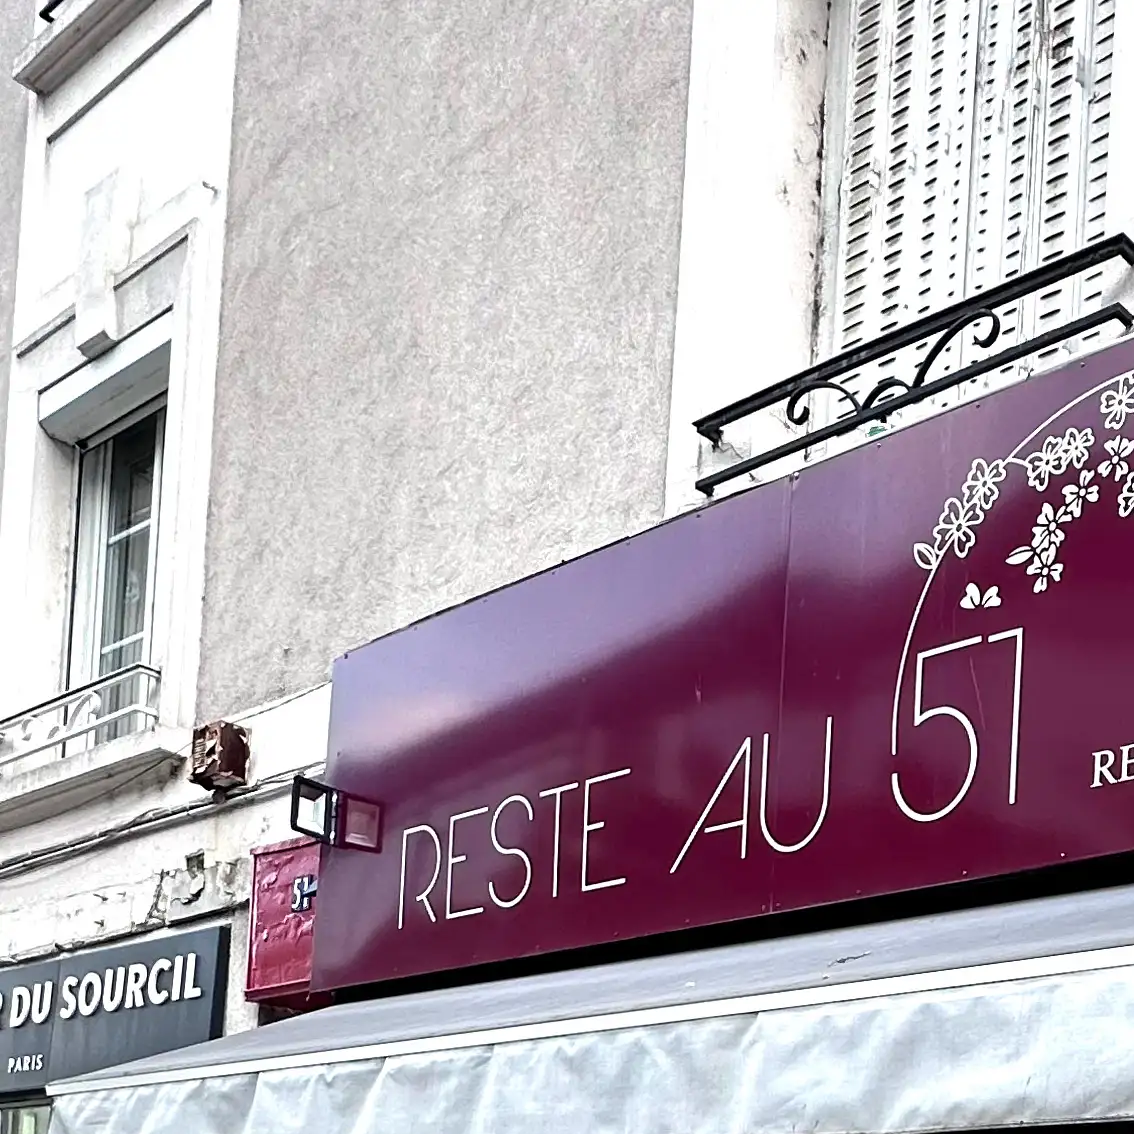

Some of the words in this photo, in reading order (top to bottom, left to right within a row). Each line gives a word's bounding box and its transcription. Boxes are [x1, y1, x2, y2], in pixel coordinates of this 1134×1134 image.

[397, 768, 632, 931] RESTE
[669, 716, 834, 874] AU
[891, 626, 1024, 822] 51
[9, 980, 53, 1029] DU
[59, 952, 202, 1021] SOURCIL
[7, 1053, 44, 1074] PARIS
